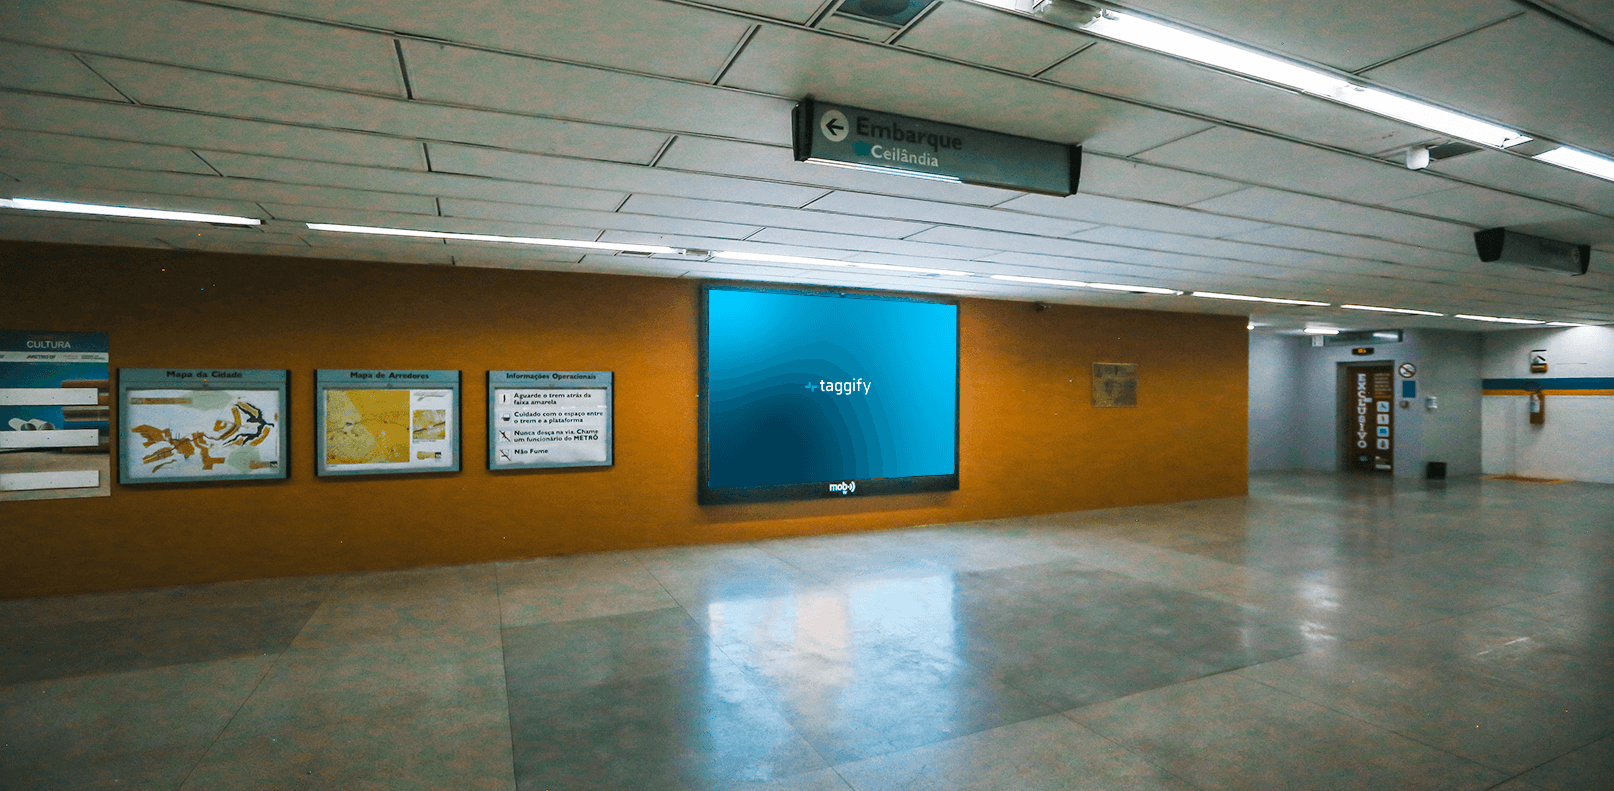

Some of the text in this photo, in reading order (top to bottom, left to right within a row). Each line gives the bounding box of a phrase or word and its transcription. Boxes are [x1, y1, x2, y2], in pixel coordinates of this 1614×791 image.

[856, 115, 963, 153] Embarque
[870, 144, 939, 168] Ceilândia
[26, 340, 71, 349] CULTURA
[166, 370, 193, 379] Mapa
[211, 370, 243, 378] Cidade
[350, 371, 373, 380] Mapa
[506, 373, 550, 381] Informações
[819, 377, 872, 396] taggify
[1357, 373, 1367, 449] EXCLUSIVO
